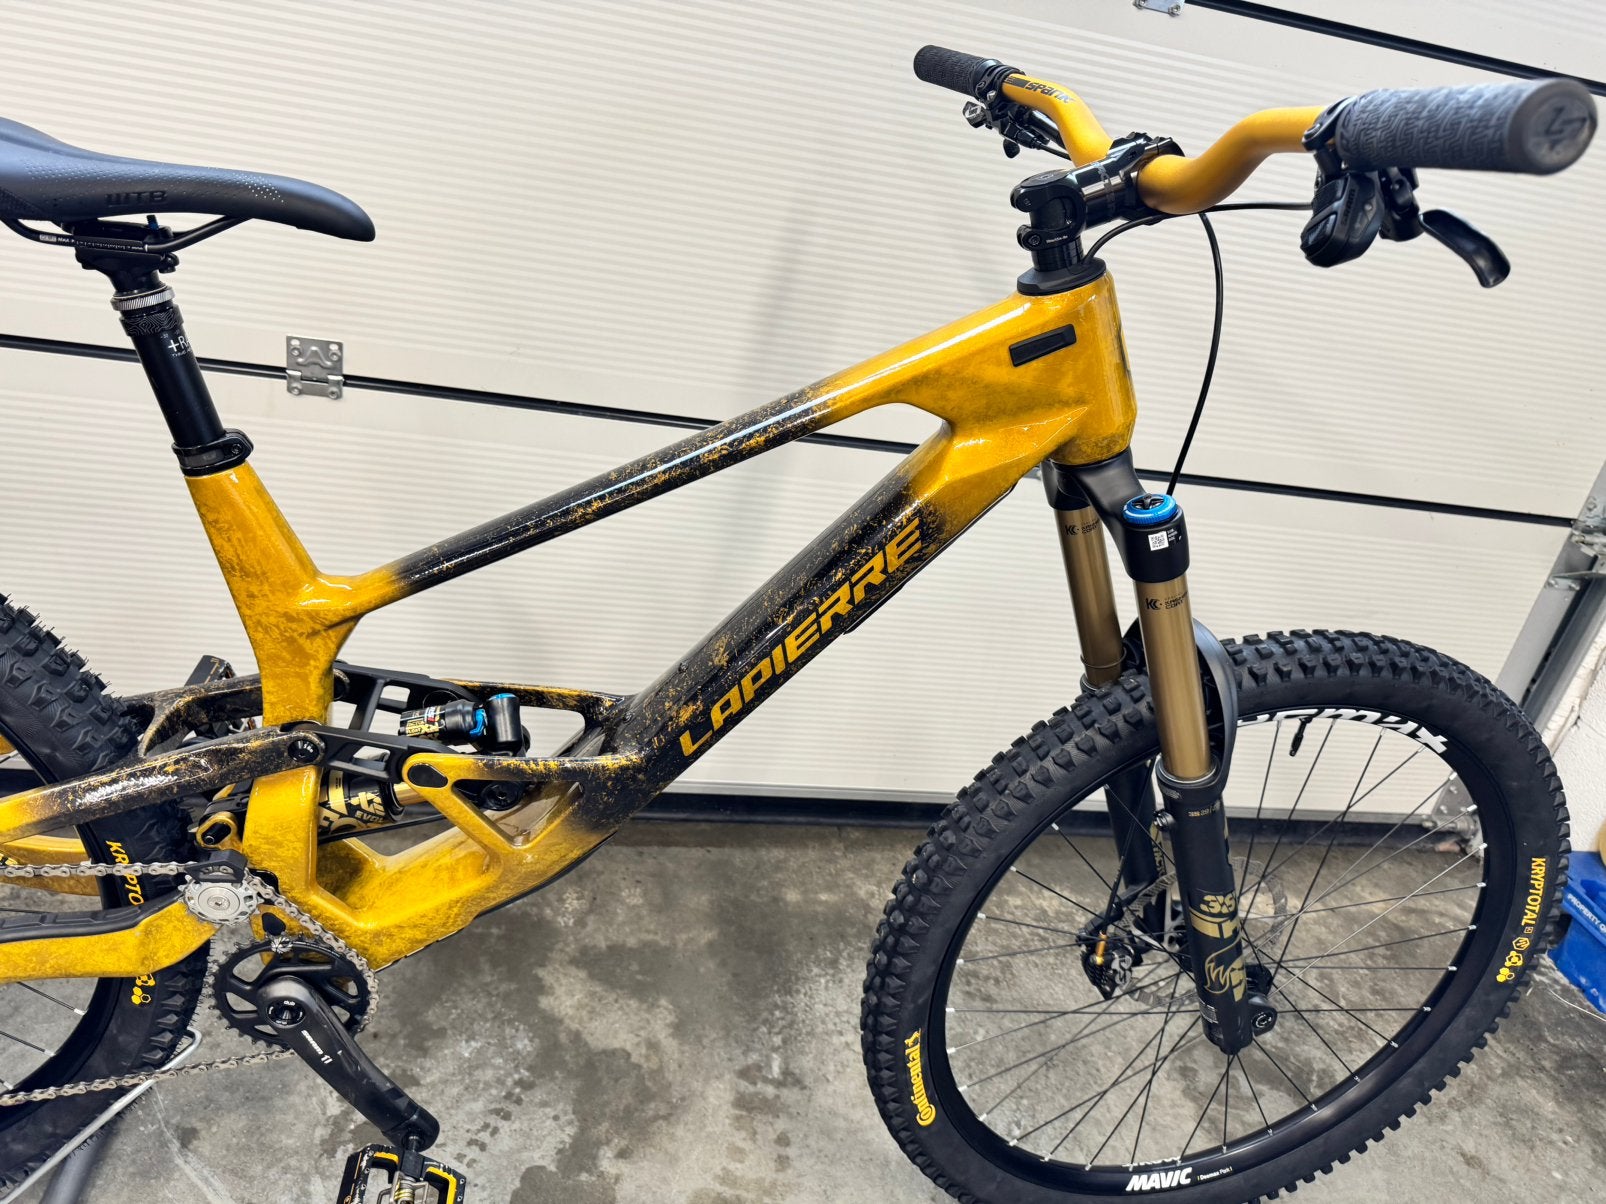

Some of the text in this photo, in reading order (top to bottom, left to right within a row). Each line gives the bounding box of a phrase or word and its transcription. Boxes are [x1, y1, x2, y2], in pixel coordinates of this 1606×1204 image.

[680, 517, 922, 757] LAPIERRE
[106, 840, 145, 906] KRPTO
[1521, 857, 1546, 926] KRYPTOTAL
[1567, 893, 1600, 924] PROPERTY
[904, 1044, 936, 1126] Continental
[1125, 1167, 1192, 1191] MAVIC
